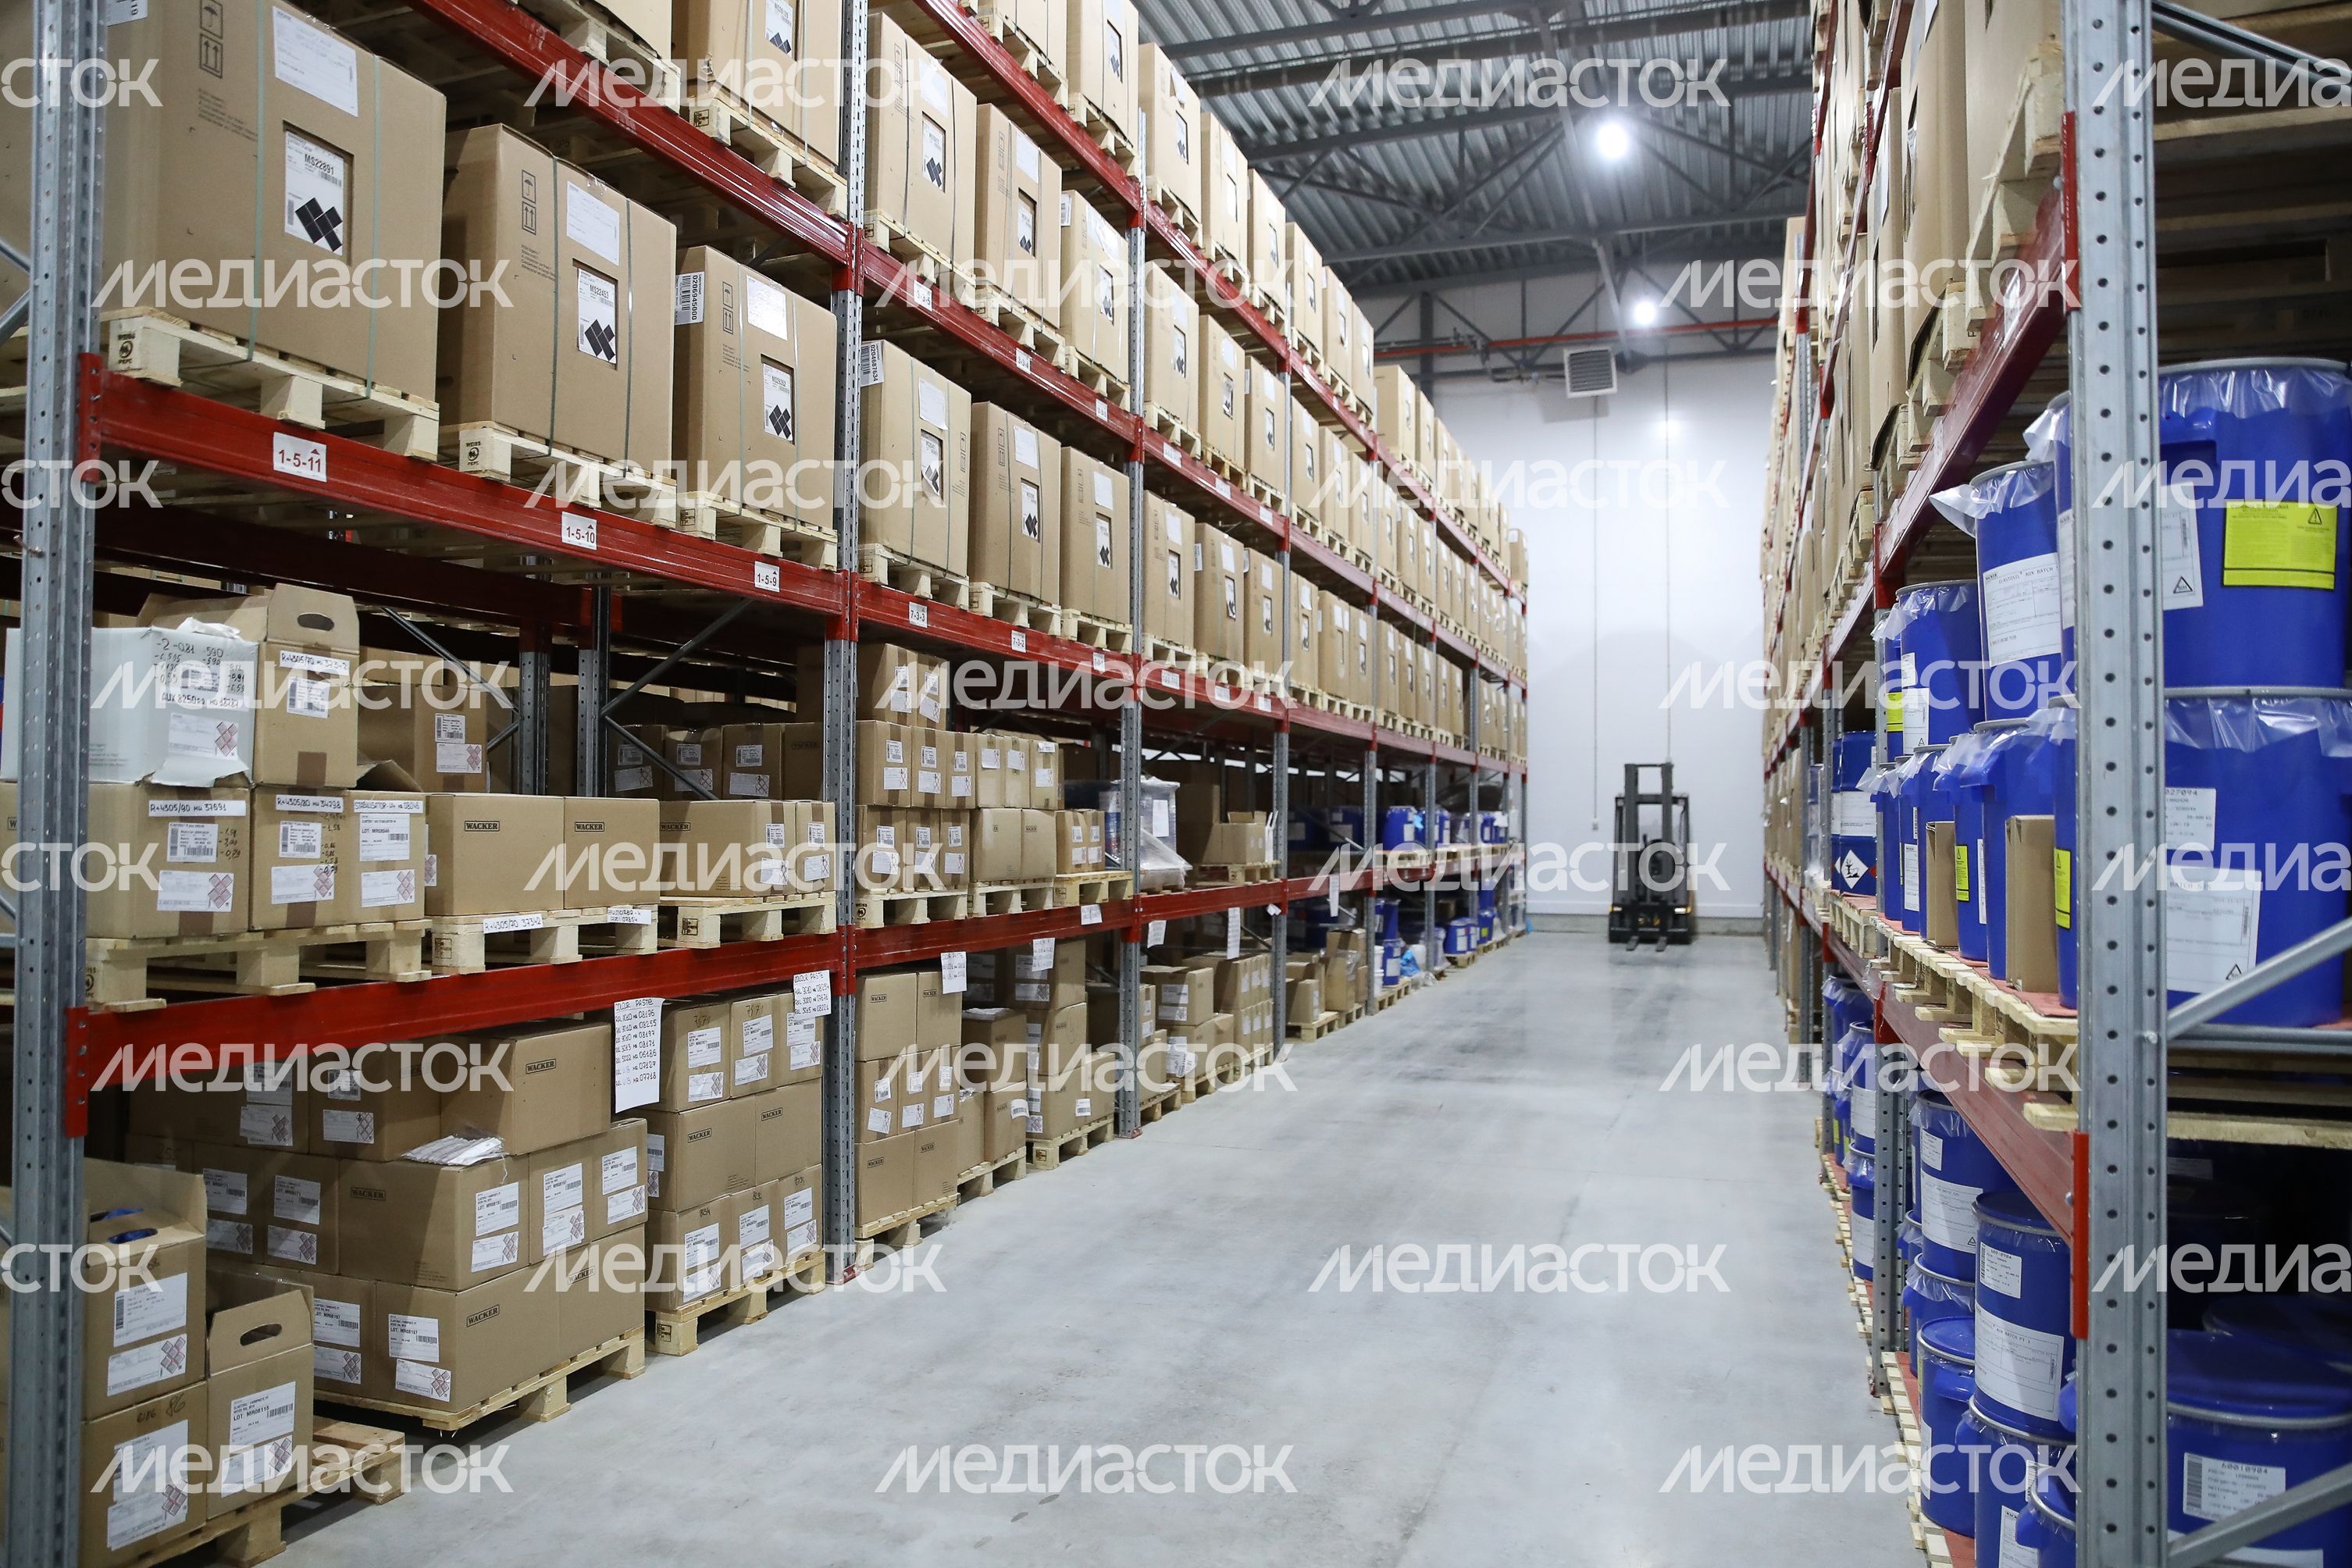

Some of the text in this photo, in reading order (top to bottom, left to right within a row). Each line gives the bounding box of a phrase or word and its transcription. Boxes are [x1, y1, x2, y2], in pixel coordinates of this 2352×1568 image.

[304, 153, 334, 175] MS22891
[870, 344, 878, 382] 0204687634
[279, 449, 321, 472] 1-5-11
[566, 526, 595, 544] 1-5-10
[757, 573, 777, 587] 1-5-9
[911, 611, 925, 622] 7-3-3
[527, 1060, 554, 1073] WACKER
[762, 1110, 782, 1120] WACKER
[689, 1130, 711, 1141] WACKER
[351, 1189, 384, 1199] WACKER
[468, 1307, 498, 1324] WACKER
